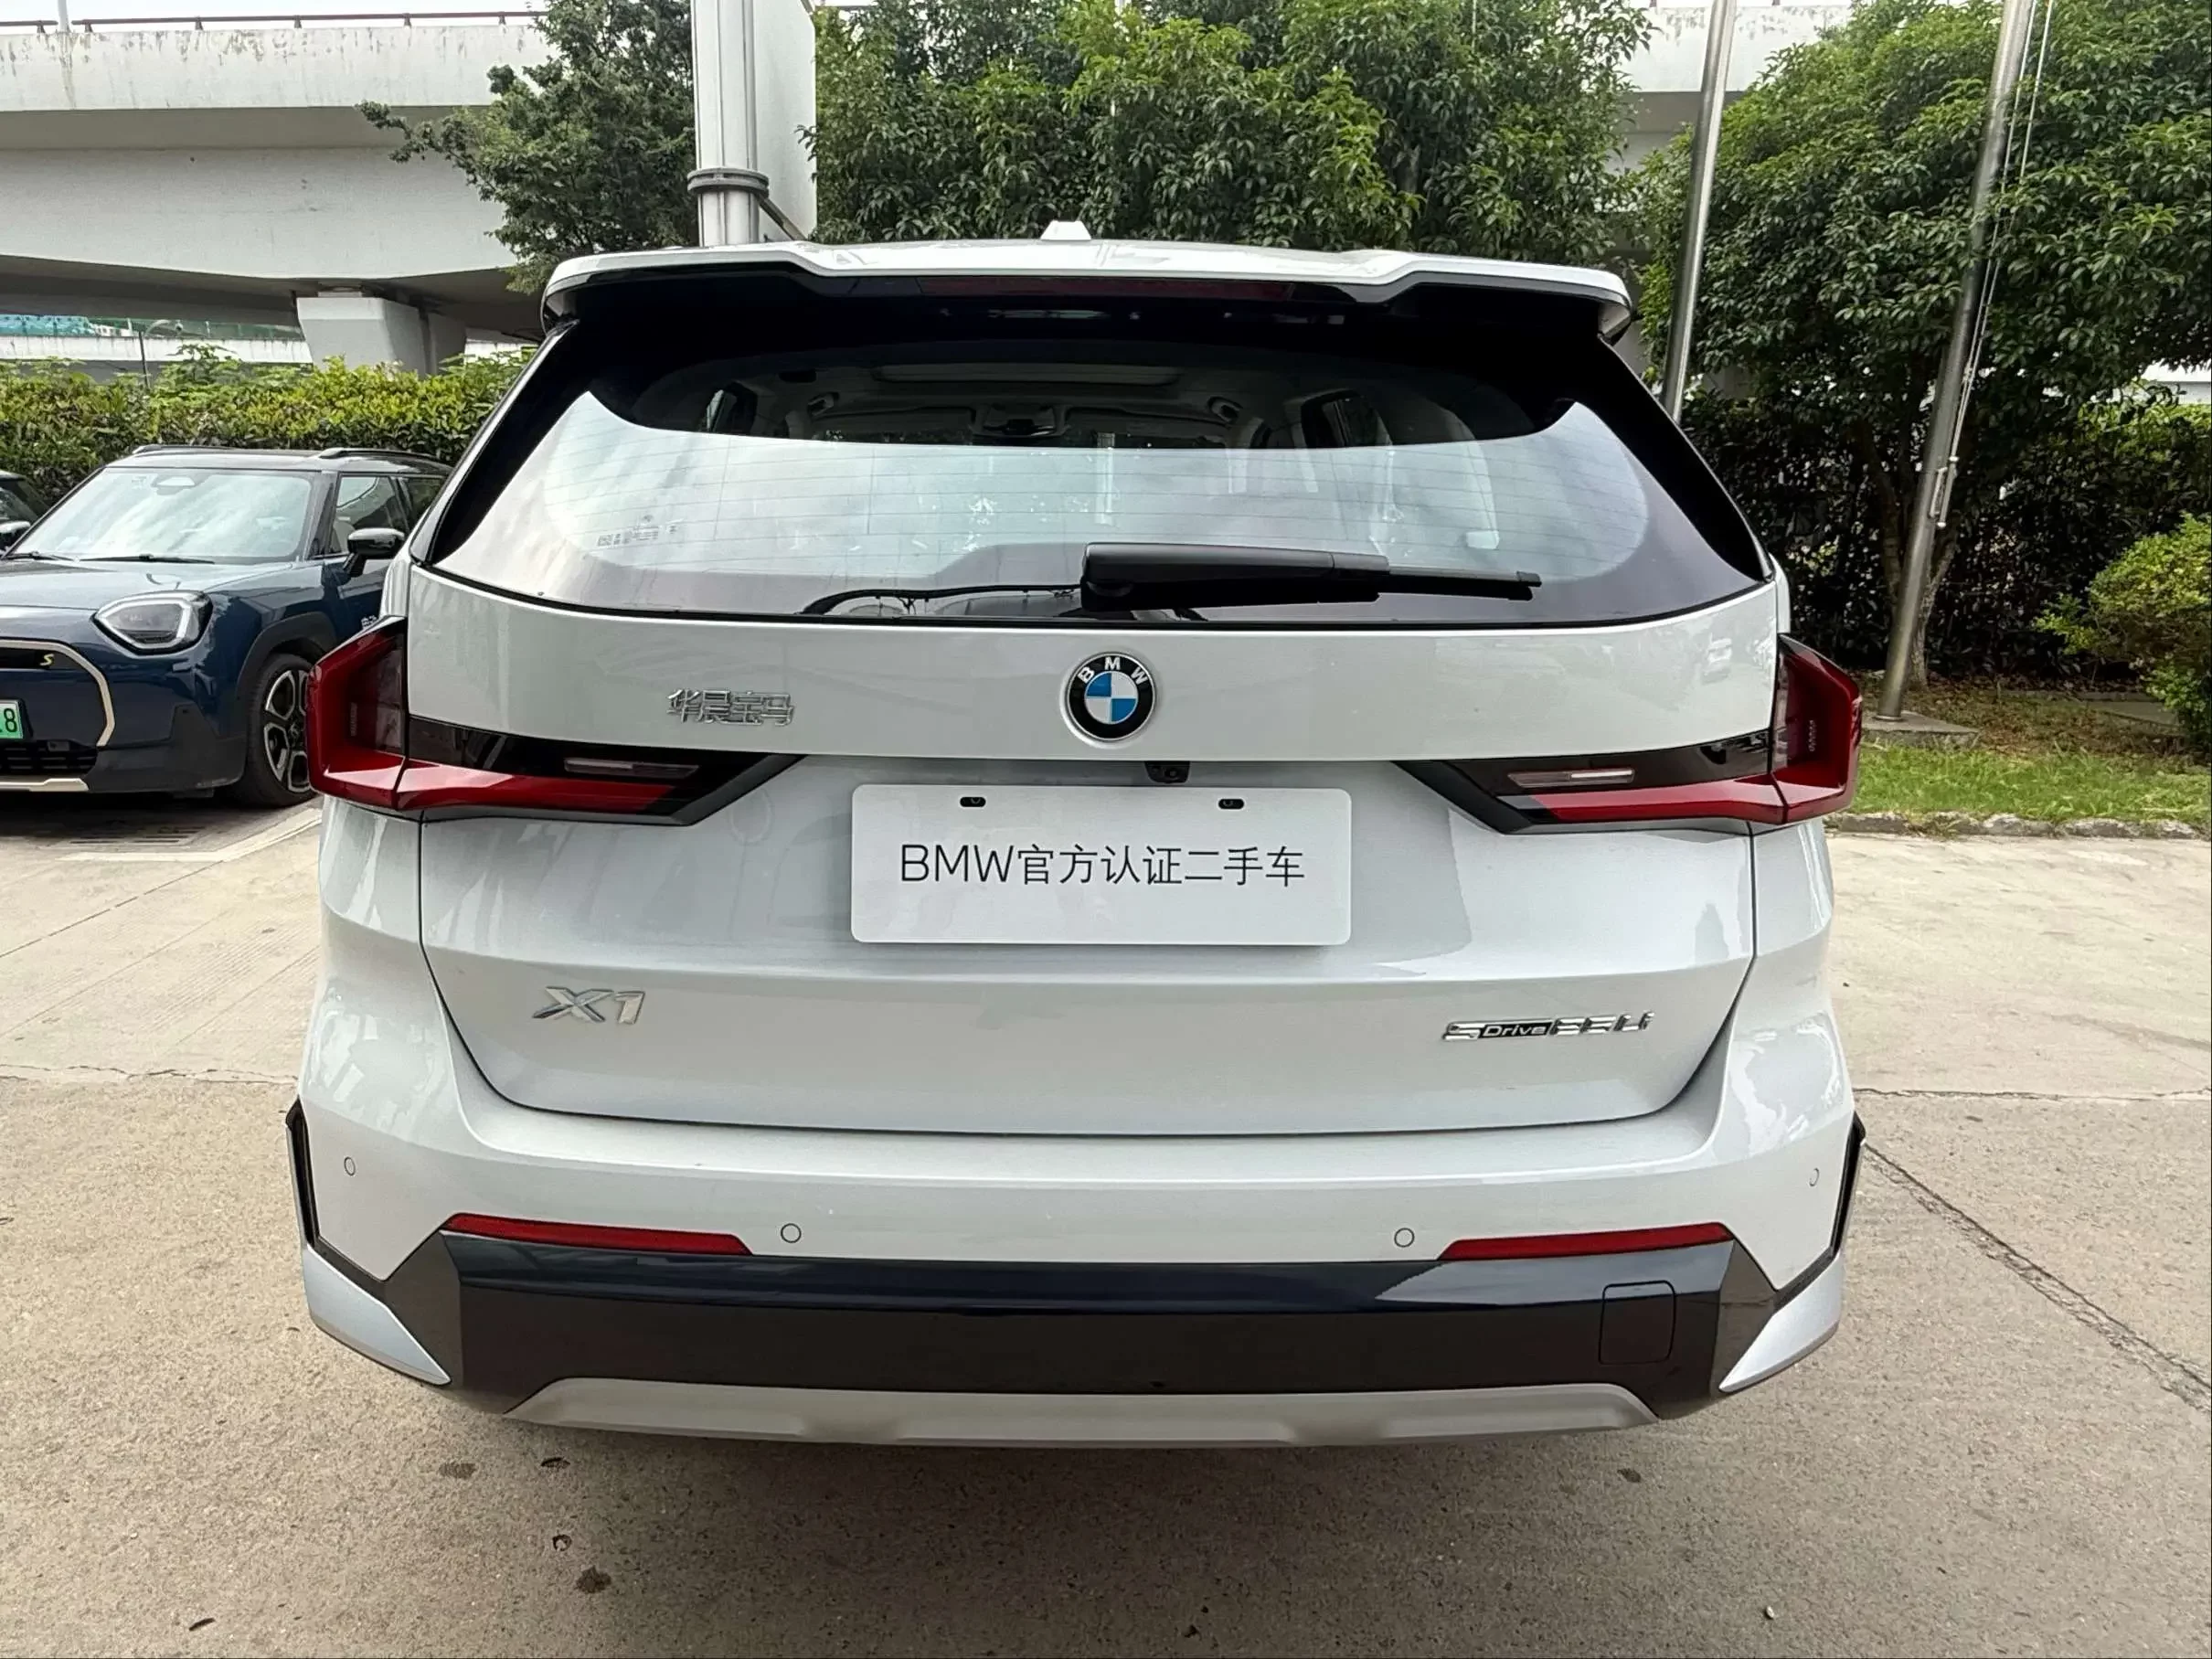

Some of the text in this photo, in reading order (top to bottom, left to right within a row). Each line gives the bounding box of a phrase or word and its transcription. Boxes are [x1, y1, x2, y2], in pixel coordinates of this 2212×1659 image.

[1077, 656, 1149, 685] BMW
[0, 707, 17, 733] 8
[667, 688, 794, 726] 华晨宝马
[900, 844, 1305, 887] BMW官方认证二手车
[531, 984, 645, 1024] X1
